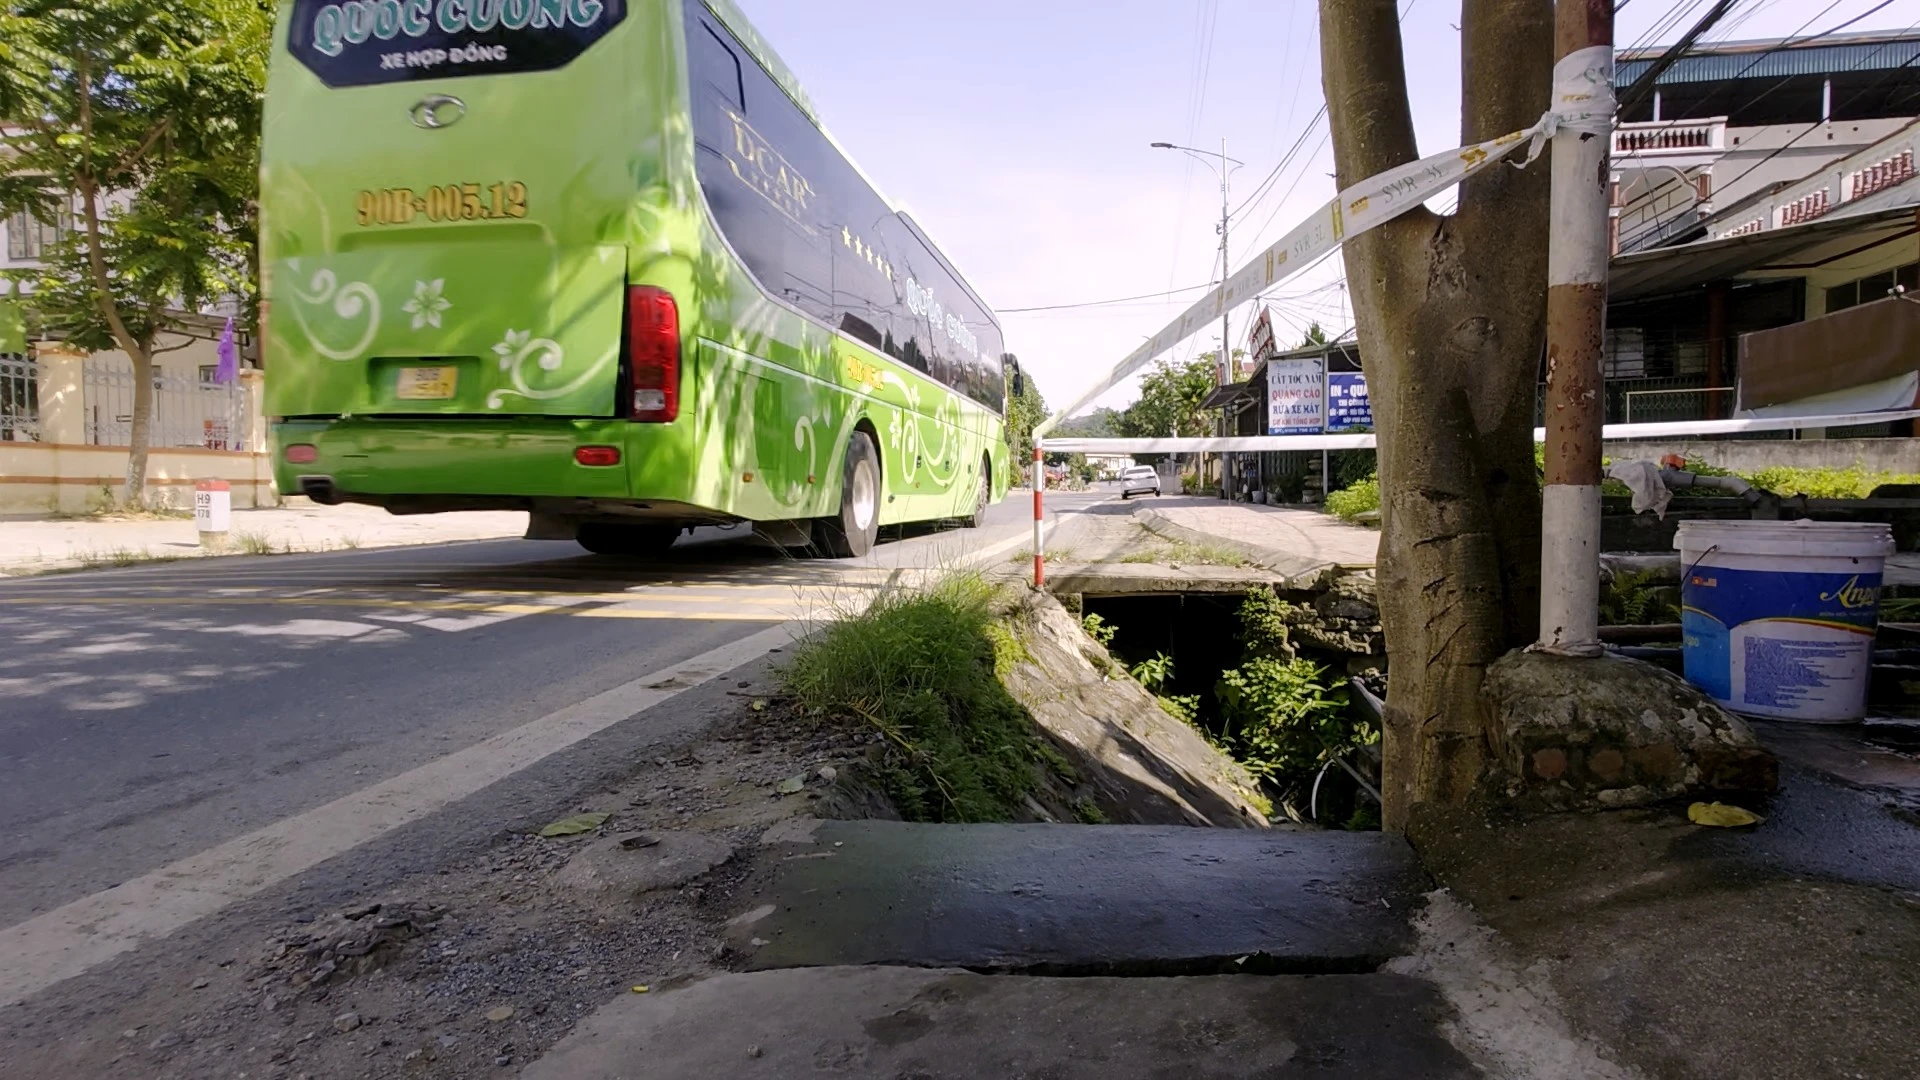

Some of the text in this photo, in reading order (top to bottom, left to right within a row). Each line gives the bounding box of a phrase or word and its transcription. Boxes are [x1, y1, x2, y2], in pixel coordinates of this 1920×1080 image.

[380, 53, 407, 69] XE
[449, 41, 507, 63] ĐỒNG
[1382, 176, 1418, 204] SVR
[356, 181, 529, 227] 90B-005.12
[1303, 385, 1321, 398] CÁO
[1291, 404, 1301, 414] XE
[197, 493, 211, 505] H9
